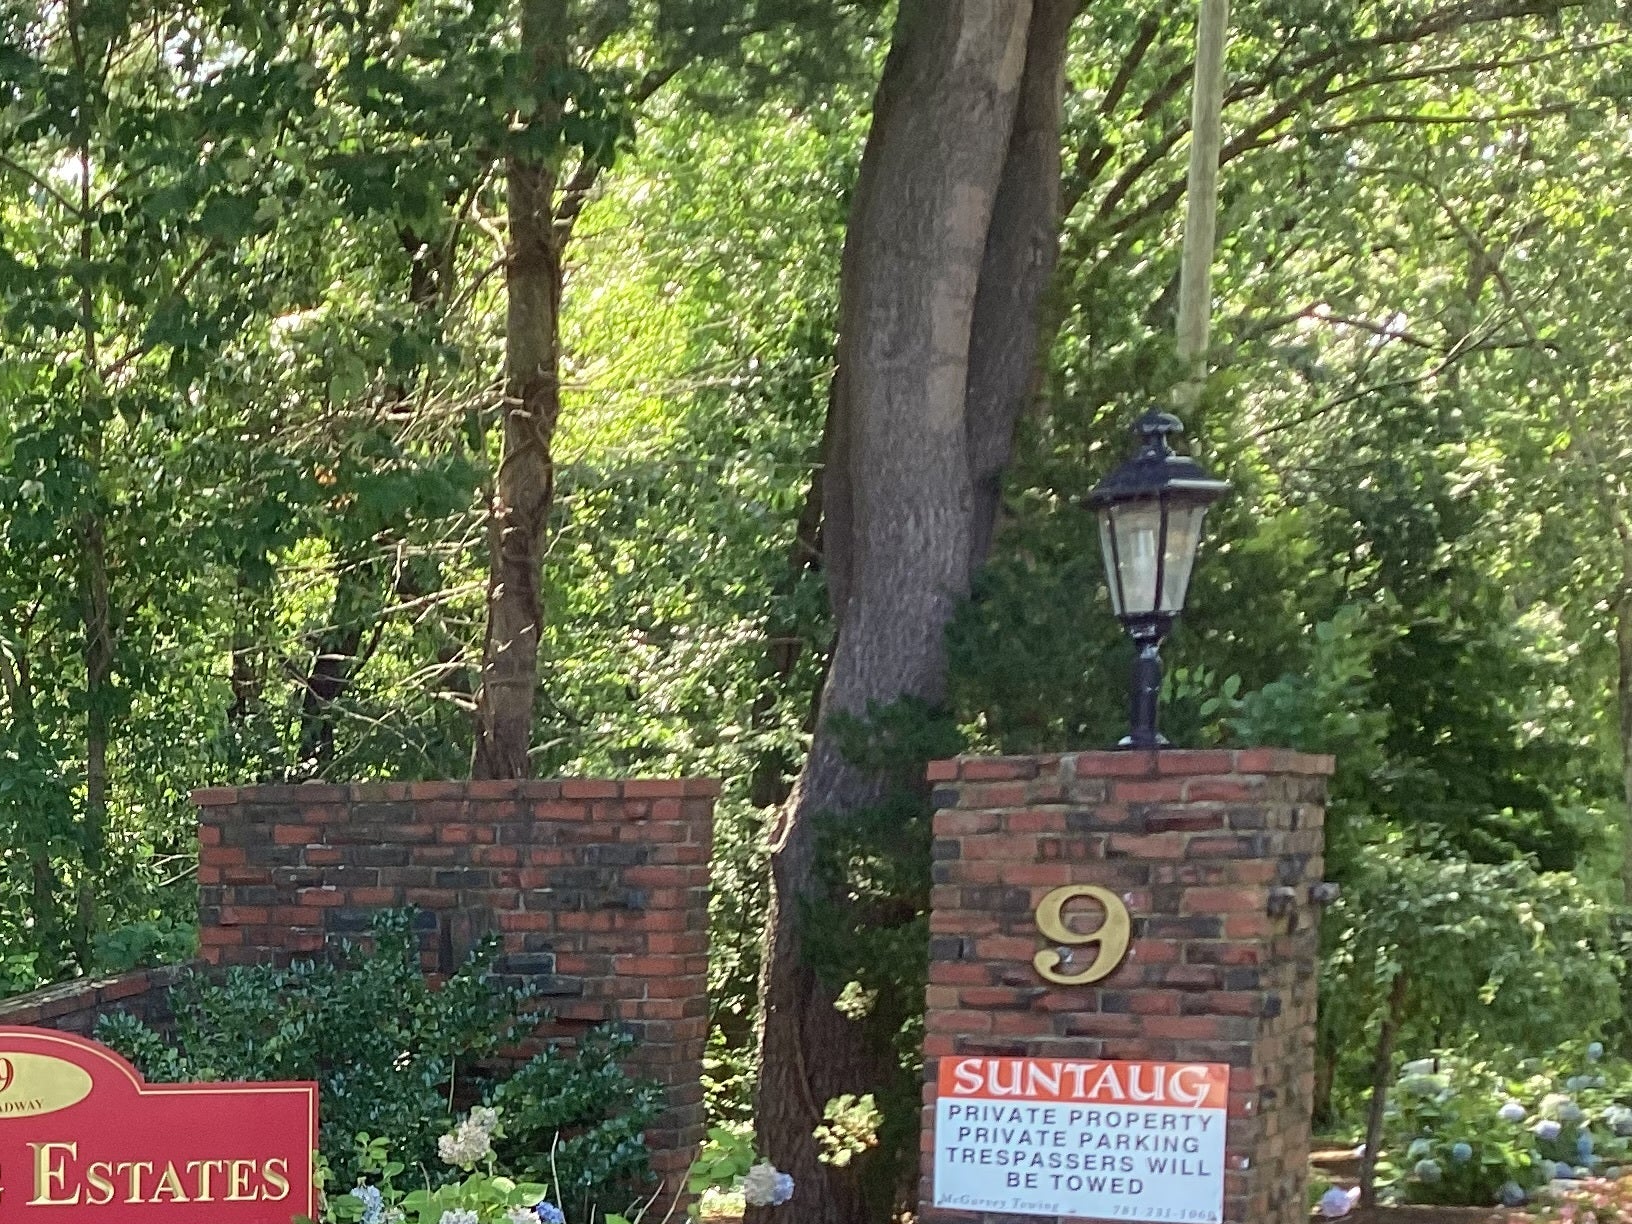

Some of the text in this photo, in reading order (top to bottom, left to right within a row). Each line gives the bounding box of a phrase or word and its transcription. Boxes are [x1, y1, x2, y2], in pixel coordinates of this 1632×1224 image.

[1033, 885, 1131, 985] 9
[953, 1058, 1212, 1108] SUNTAUG
[947, 1104, 1213, 1132] PRIVATE PROPERTY
[958, 1126, 1201, 1153] PRIVATE PARKING
[945, 1147, 1212, 1177] TRESPASSERS WILL
[1006, 1172, 1145, 1195] BE TOWED
